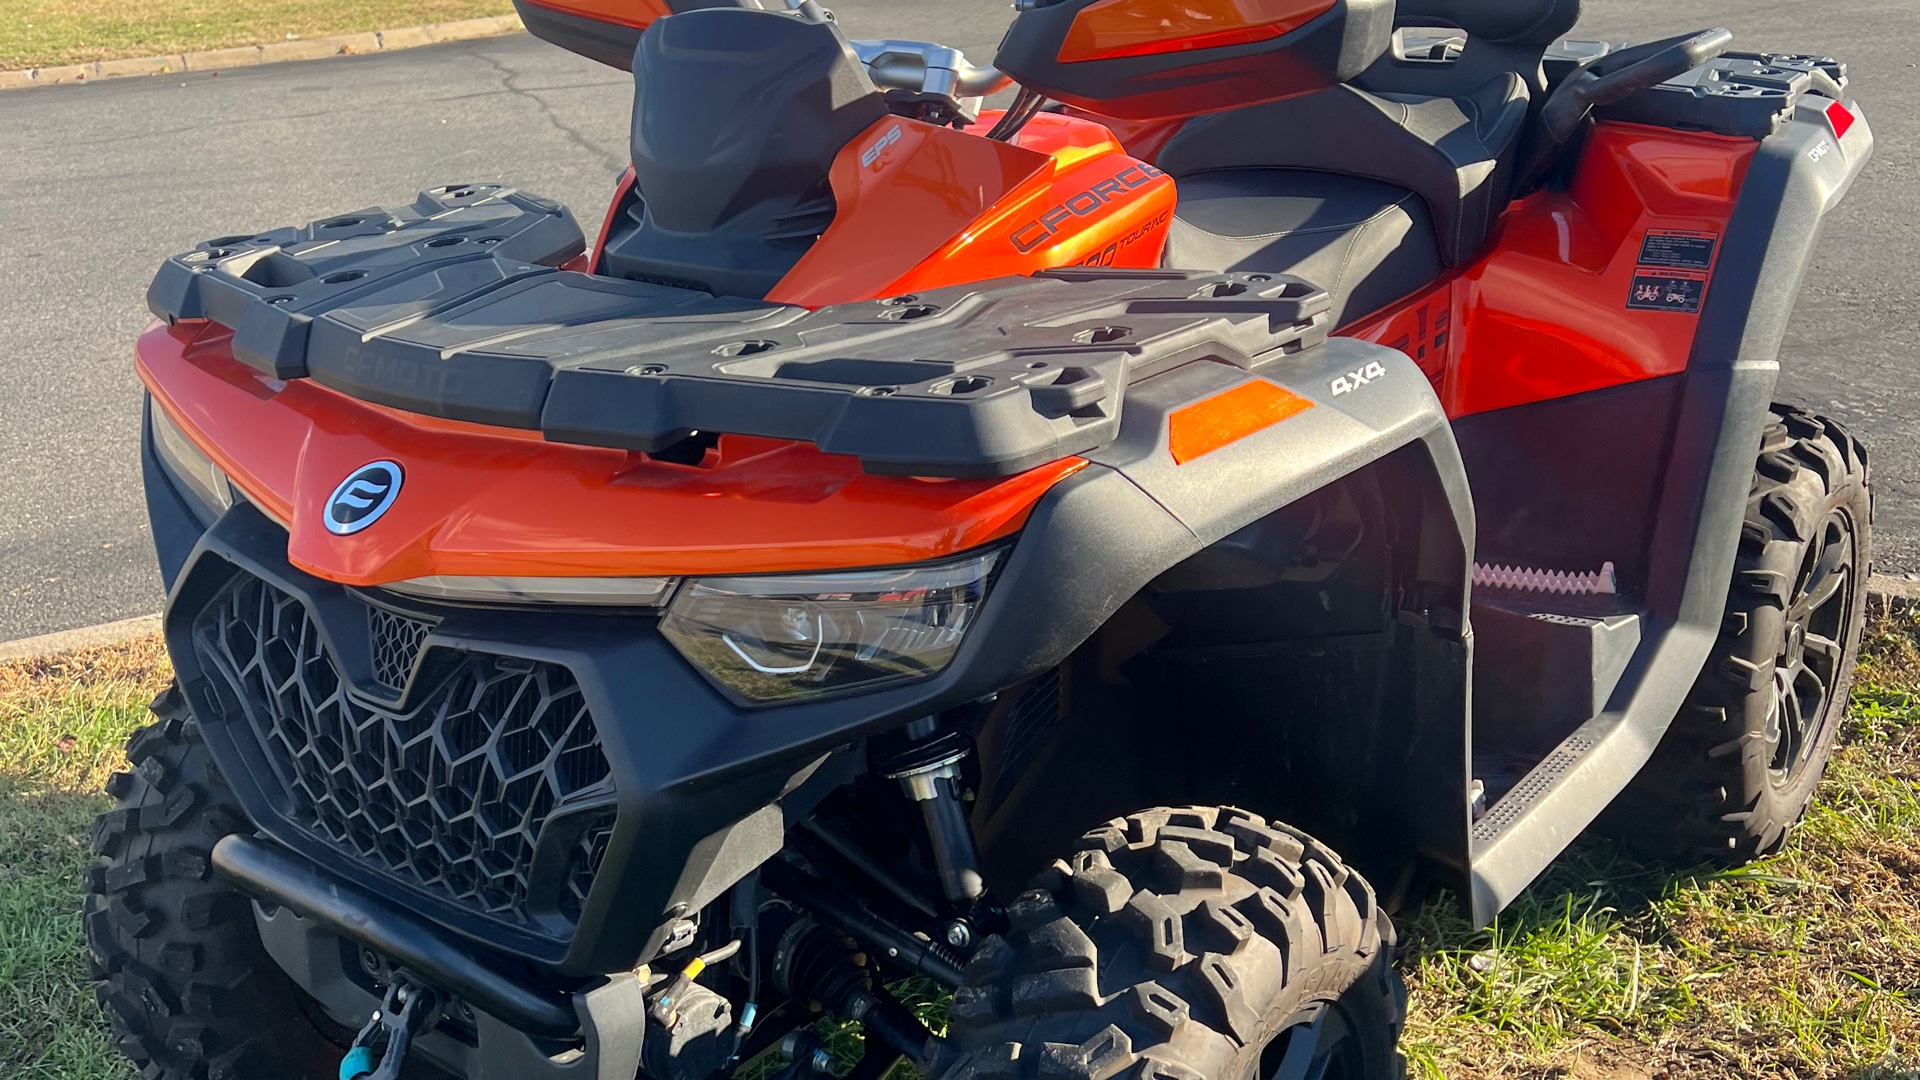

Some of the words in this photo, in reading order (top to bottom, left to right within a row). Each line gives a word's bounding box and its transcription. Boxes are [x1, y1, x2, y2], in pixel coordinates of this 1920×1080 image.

[861, 124, 902, 168] EPS
[1009, 163, 1164, 253] CFORCE
[1074, 242, 1118, 268] 00
[1119, 210, 1169, 249] TOURING
[344, 345, 467, 395] CFMOTO
